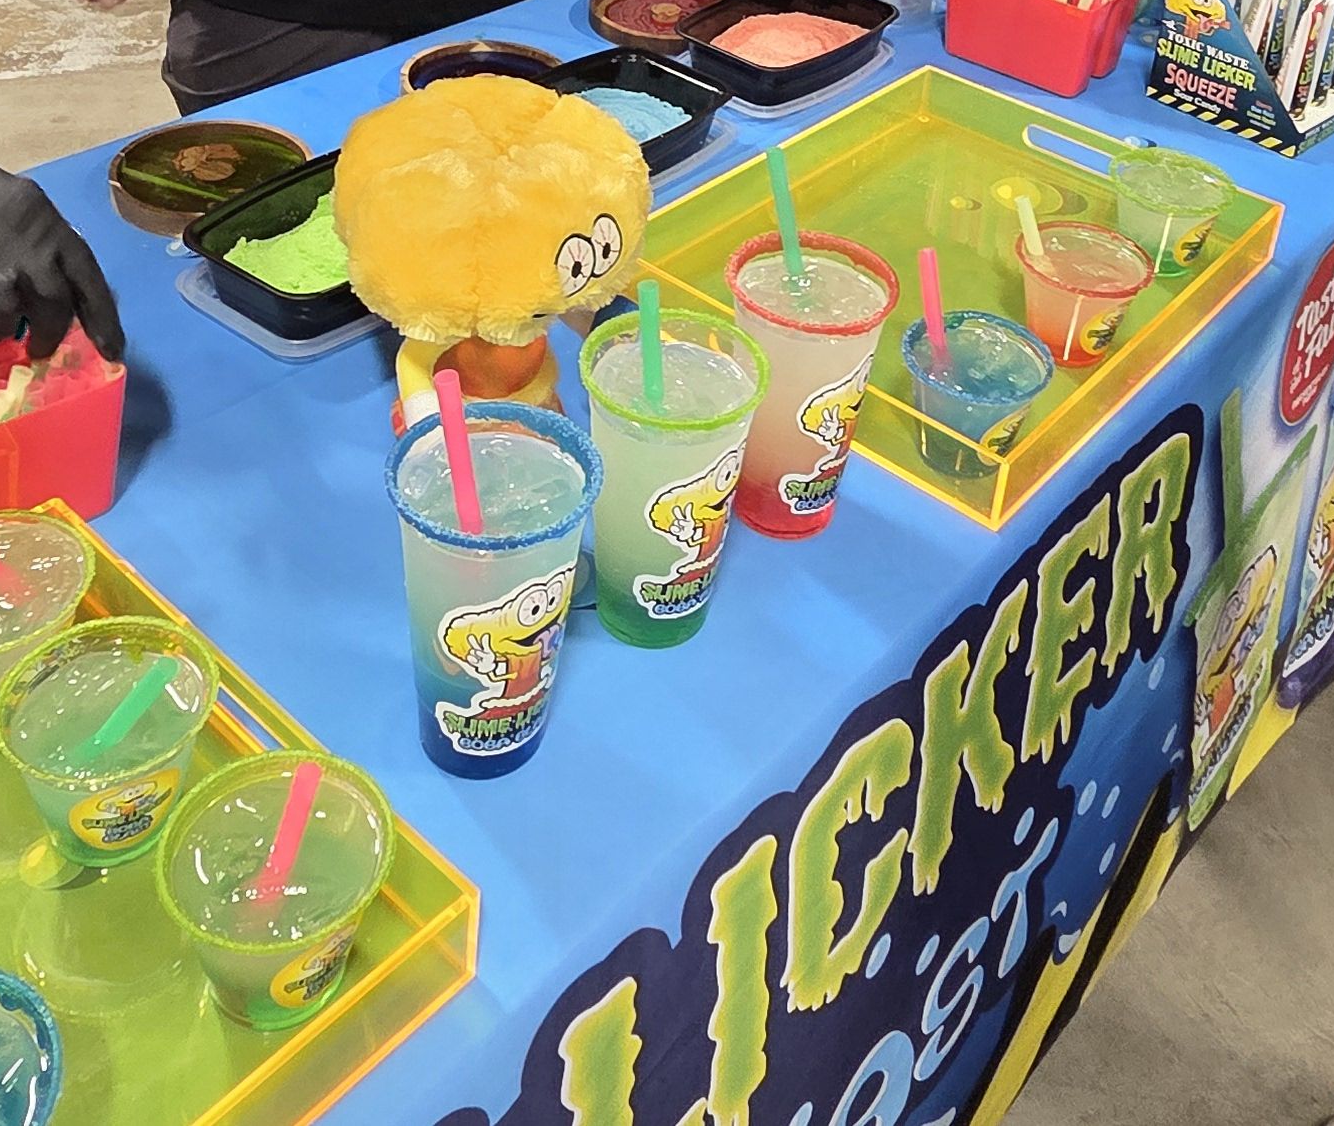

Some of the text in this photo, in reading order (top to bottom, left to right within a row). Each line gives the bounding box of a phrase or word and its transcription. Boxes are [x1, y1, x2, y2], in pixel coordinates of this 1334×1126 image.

[1167, 30, 1250, 70] TOXIC WASTE
[1157, 38, 1256, 92] SLIME LICKER
[1164, 62, 1238, 111] SQUEEZE
[1173, 88, 1222, 114] Sour Candy
[786, 475, 837, 500] SLIME
[641, 578, 700, 604] SLIME
[654, 598, 697, 614] BOBA
[444, 711, 513, 738] SLIME
[459, 737, 511, 751] BOBA
[560, 431, 1193, 1126] LICKER
